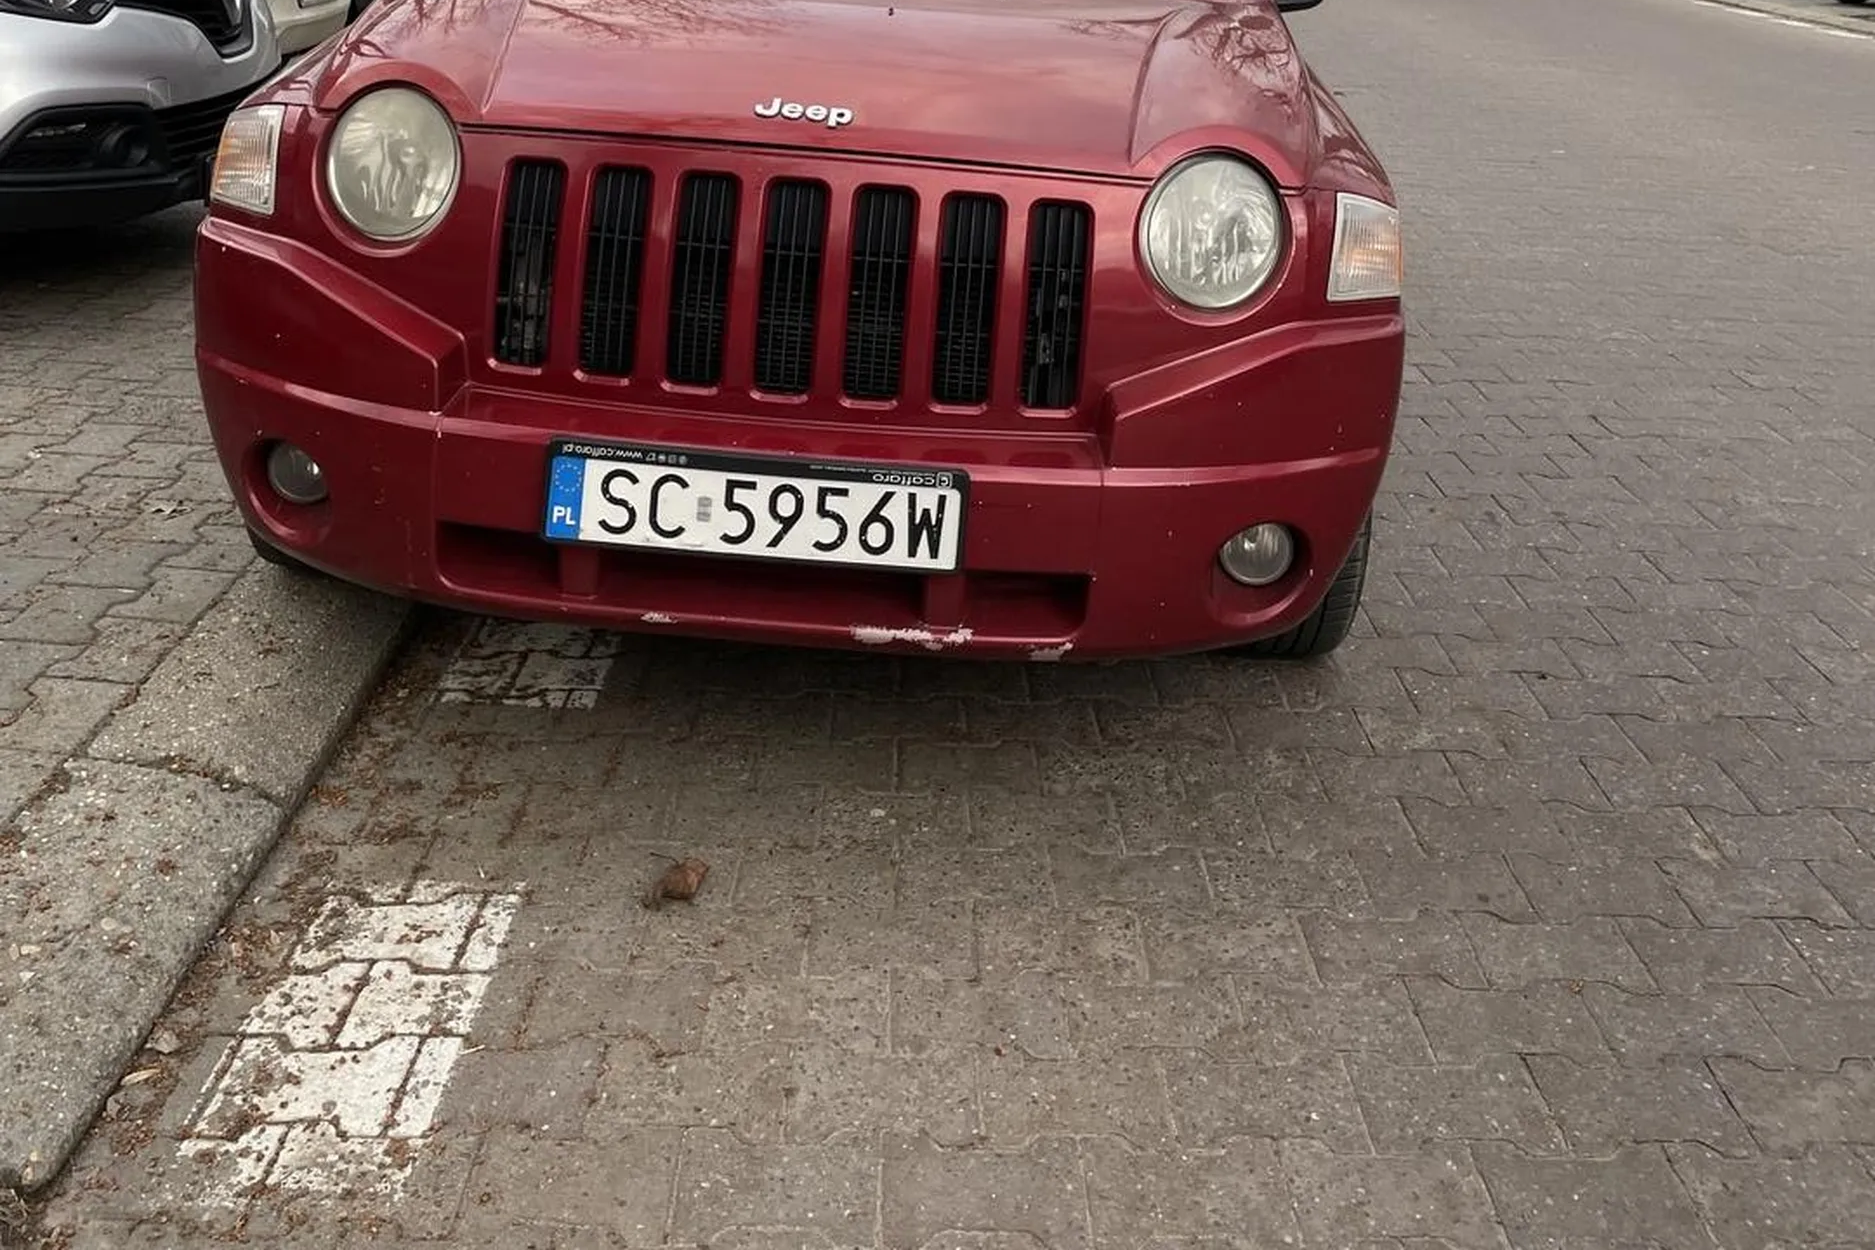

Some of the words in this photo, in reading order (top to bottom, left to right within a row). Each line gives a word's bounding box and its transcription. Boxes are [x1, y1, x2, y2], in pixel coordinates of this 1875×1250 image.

[754, 97, 853, 129] Jeep
[872, 472, 936, 487] caffaro
[552, 505, 577, 526] PL
[598, 468, 690, 540] SC
[719, 478, 948, 560] 5956W
